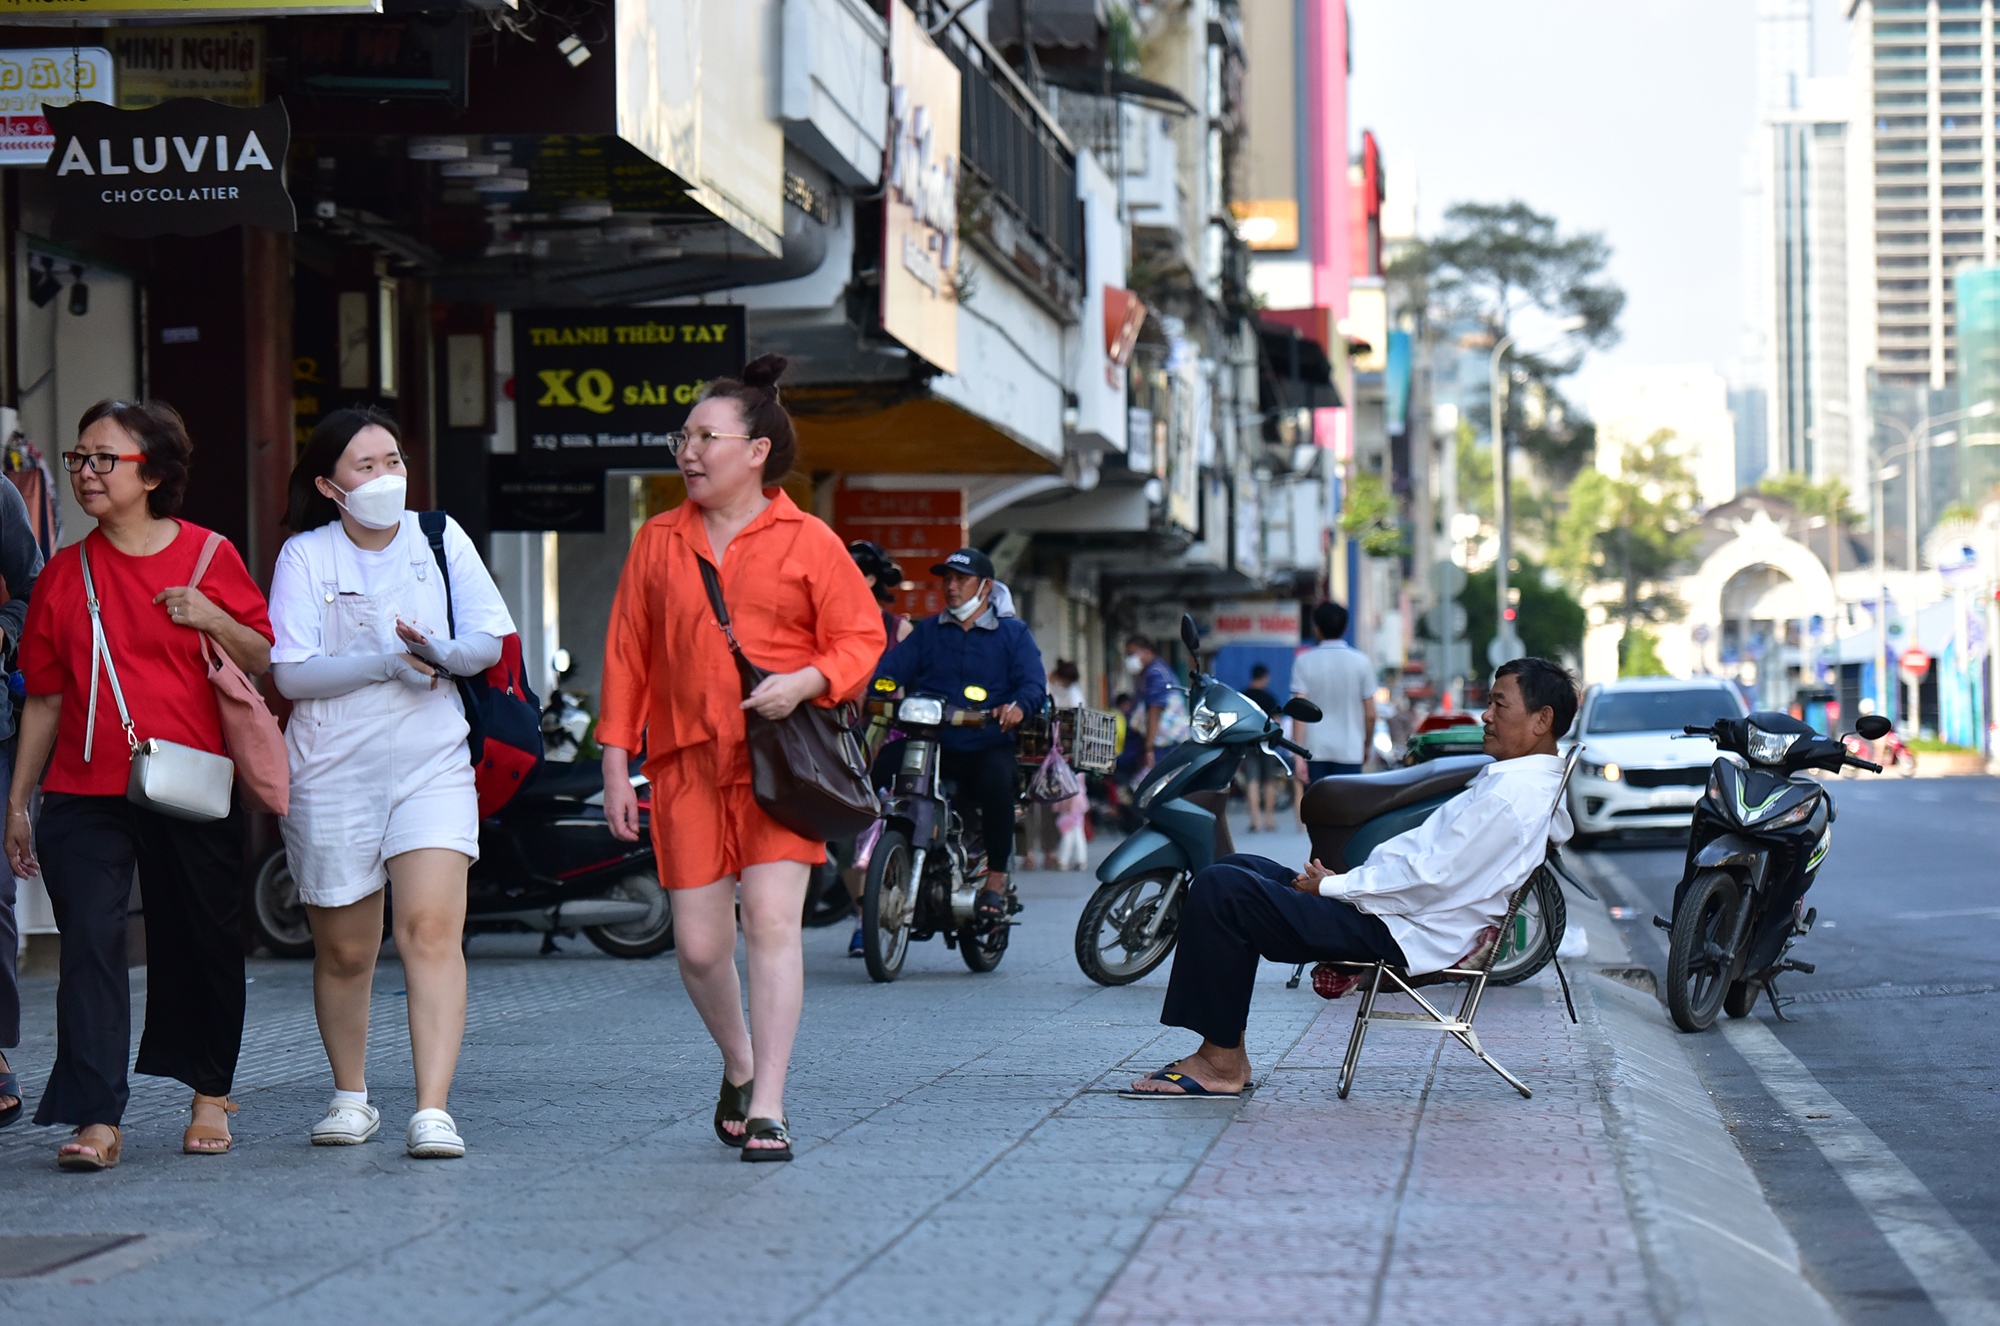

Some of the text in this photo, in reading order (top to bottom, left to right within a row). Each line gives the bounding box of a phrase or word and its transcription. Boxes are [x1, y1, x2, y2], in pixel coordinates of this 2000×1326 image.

[56, 130, 273, 176] ALUVIA
[101, 186, 239, 203] CHOCOLATIER
[529, 321, 728, 346] TRANH THÊU TAY
[537, 368, 615, 414] XQ
[622, 380, 668, 406] SÀI
[532, 434, 558, 451] XQ
